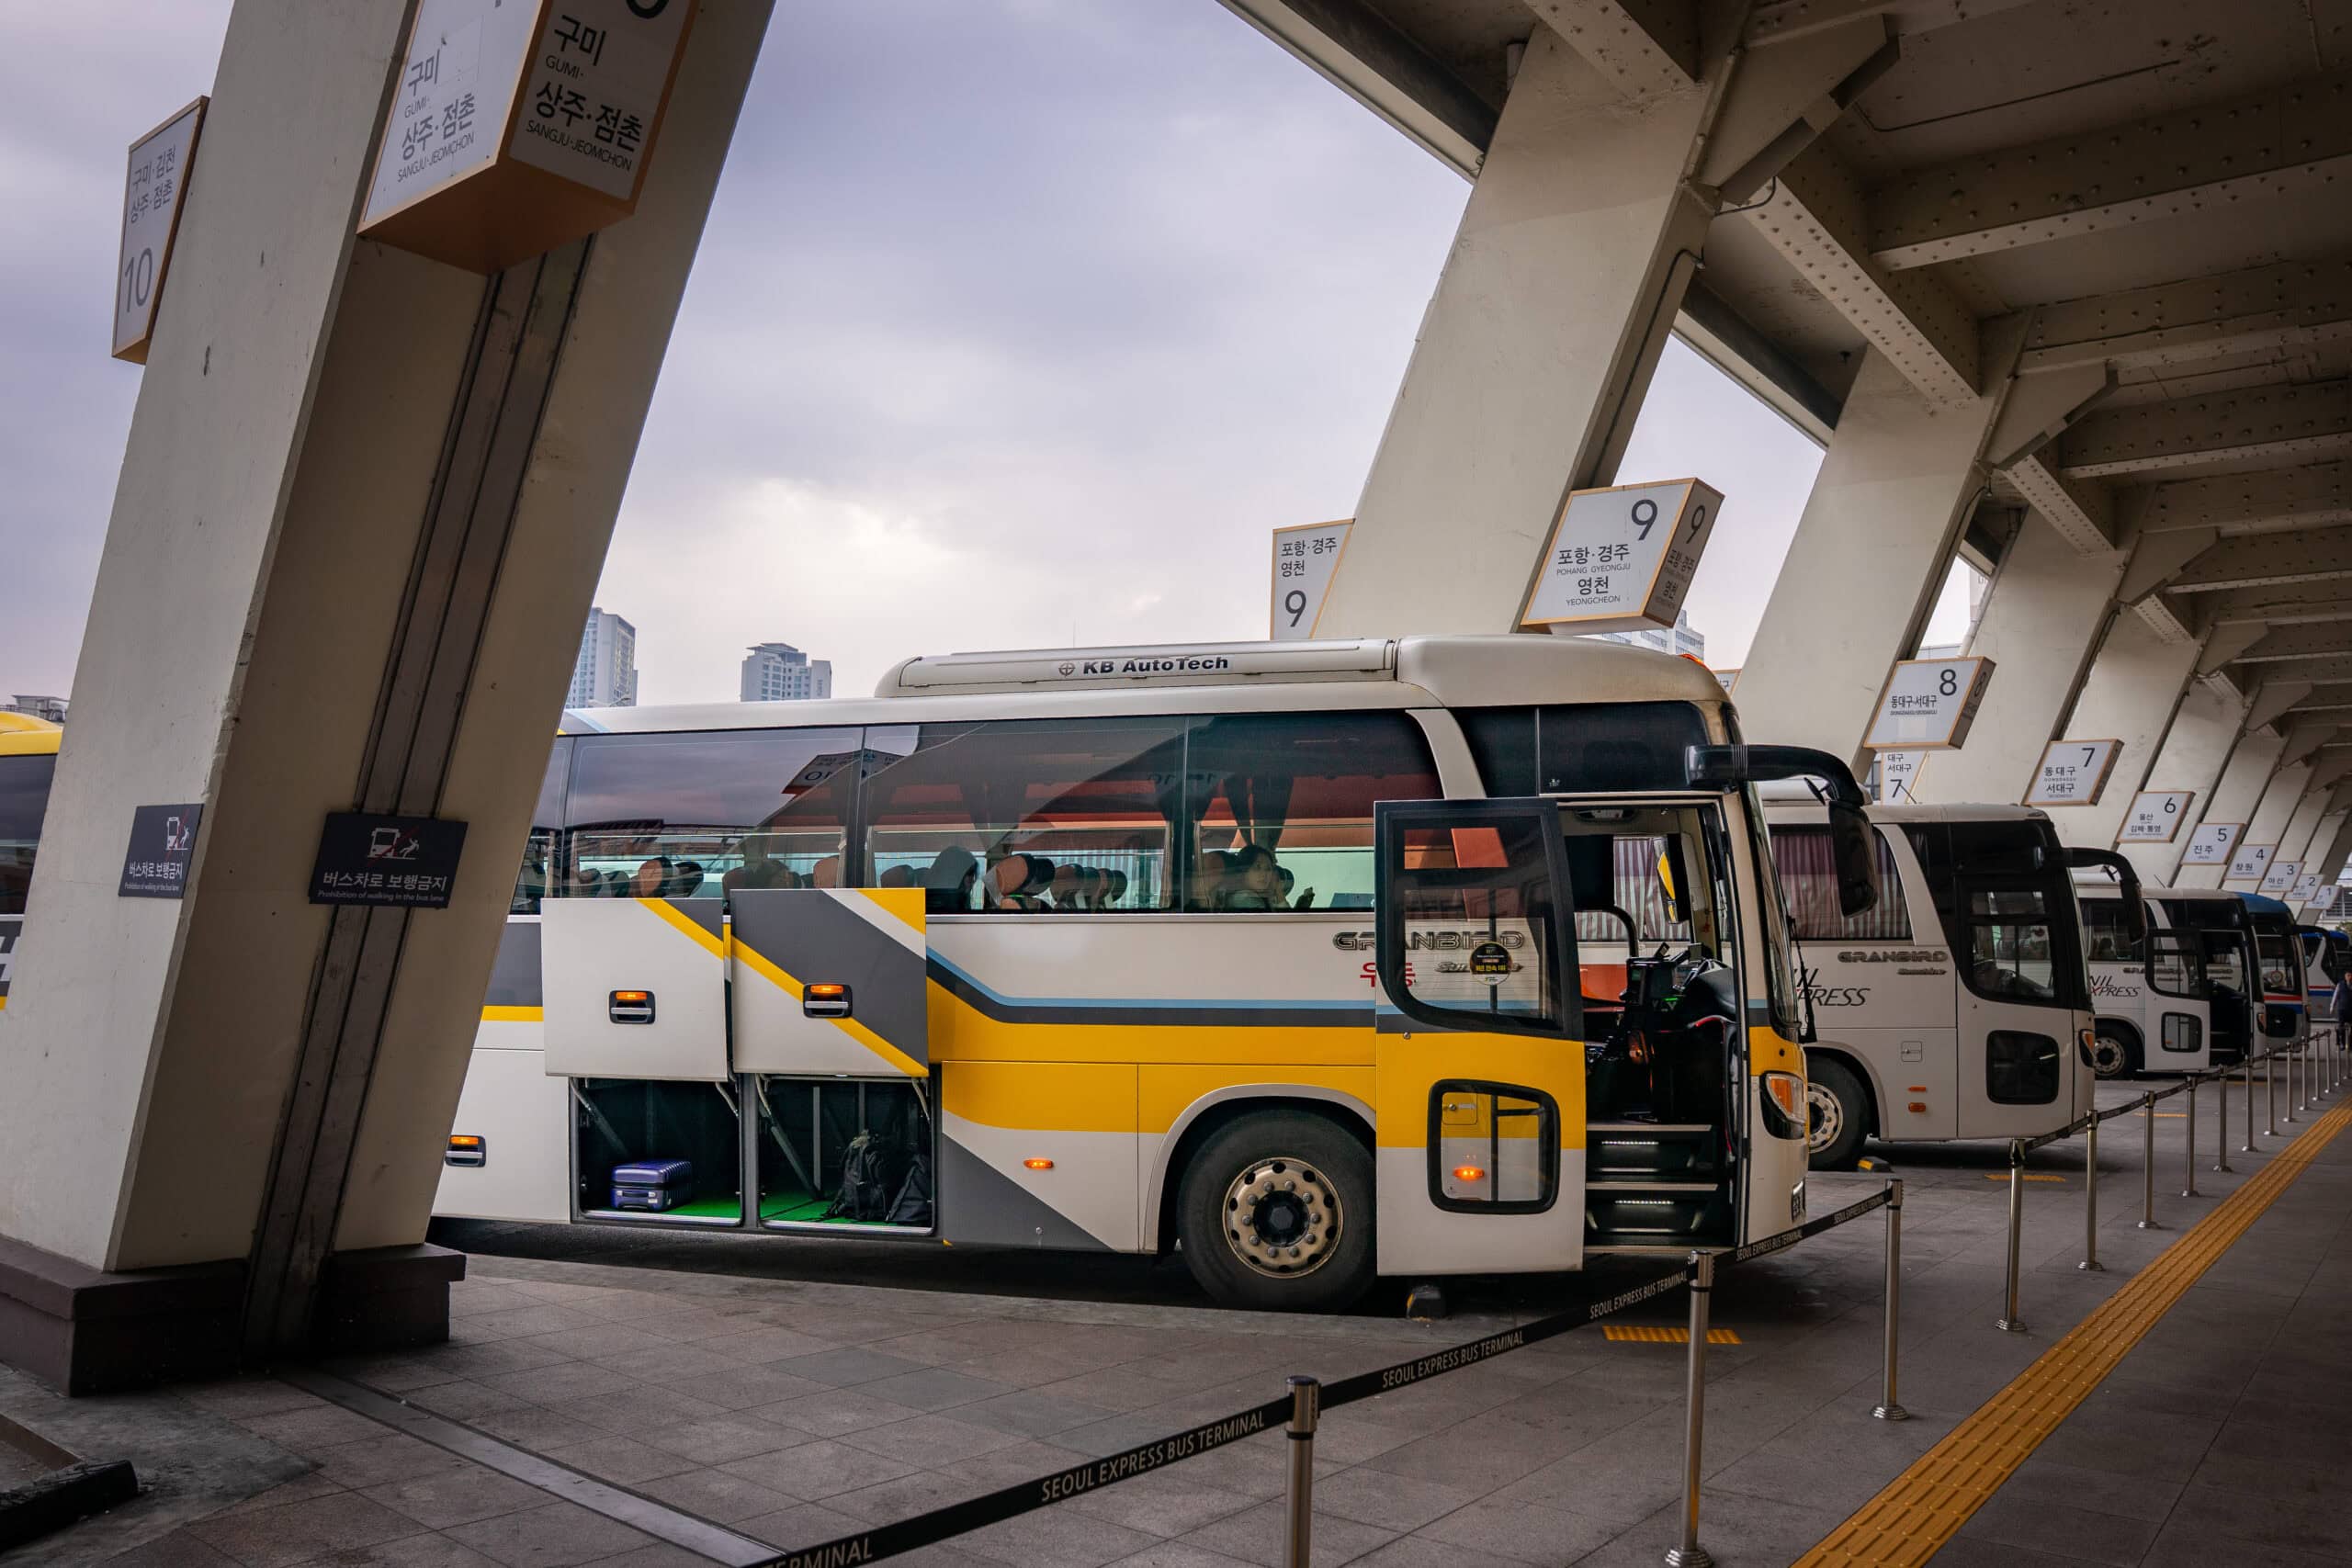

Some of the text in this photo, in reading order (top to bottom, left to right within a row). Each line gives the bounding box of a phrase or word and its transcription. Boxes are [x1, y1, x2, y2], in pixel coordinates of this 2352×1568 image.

[554, 14, 606, 66] 구미
[407, 49, 441, 96] 구미
[536, 81, 642, 152] 상주·점촌
[402, 93, 475, 161] 상주·점촌
[526, 119, 632, 172] SANGJU·JEOMCHON
[397, 131, 475, 183] SANGJU·JEOMCHON
[125, 247, 153, 312] 10
[1631, 499, 1658, 541] 9
[1686, 504, 1706, 544] 9
[1281, 536, 1338, 557] 포항·경주
[1557, 543, 1630, 565] 포항·경주
[1281, 559, 1305, 578] 영천
[1556, 563, 1631, 576] POHANG GYEONGJU
[1577, 575, 1609, 595] 영천
[1284, 590, 1306, 627] 9
[1566, 595, 1621, 607] YEONGCHEON
[1082, 657, 1228, 674] KB AutoTech
[1939, 669, 1957, 696] 8
[1887, 753, 1904, 762] 대구
[2081, 747, 2096, 767] 7
[1887, 763, 1912, 773] 서대구
[1890, 779, 1903, 798] 7
[2164, 796, 2177, 814] 6
[2217, 828, 2227, 842] 5
[2256, 849, 2265, 860] 4
[129, 861, 155, 879] 버스차로
[2287, 864, 2294, 875] 3
[323, 871, 447, 893] 버스차로 보행금지
[2308, 876, 2316, 886] 2
[317, 889, 357, 898] Prohibition
[2326, 887, 2332, 897] 1
[1838, 951, 1949, 963] GRANBIRD
[1589, 1270, 1688, 1319] SEOUL EXPRESS BUS TERMINAL
[1382, 1331, 1524, 1388] SEOUL EXPRESS BUS TERMINAL
[1041, 1411, 1265, 1502] SEOUL EXPRESS BUS TERMINAL
